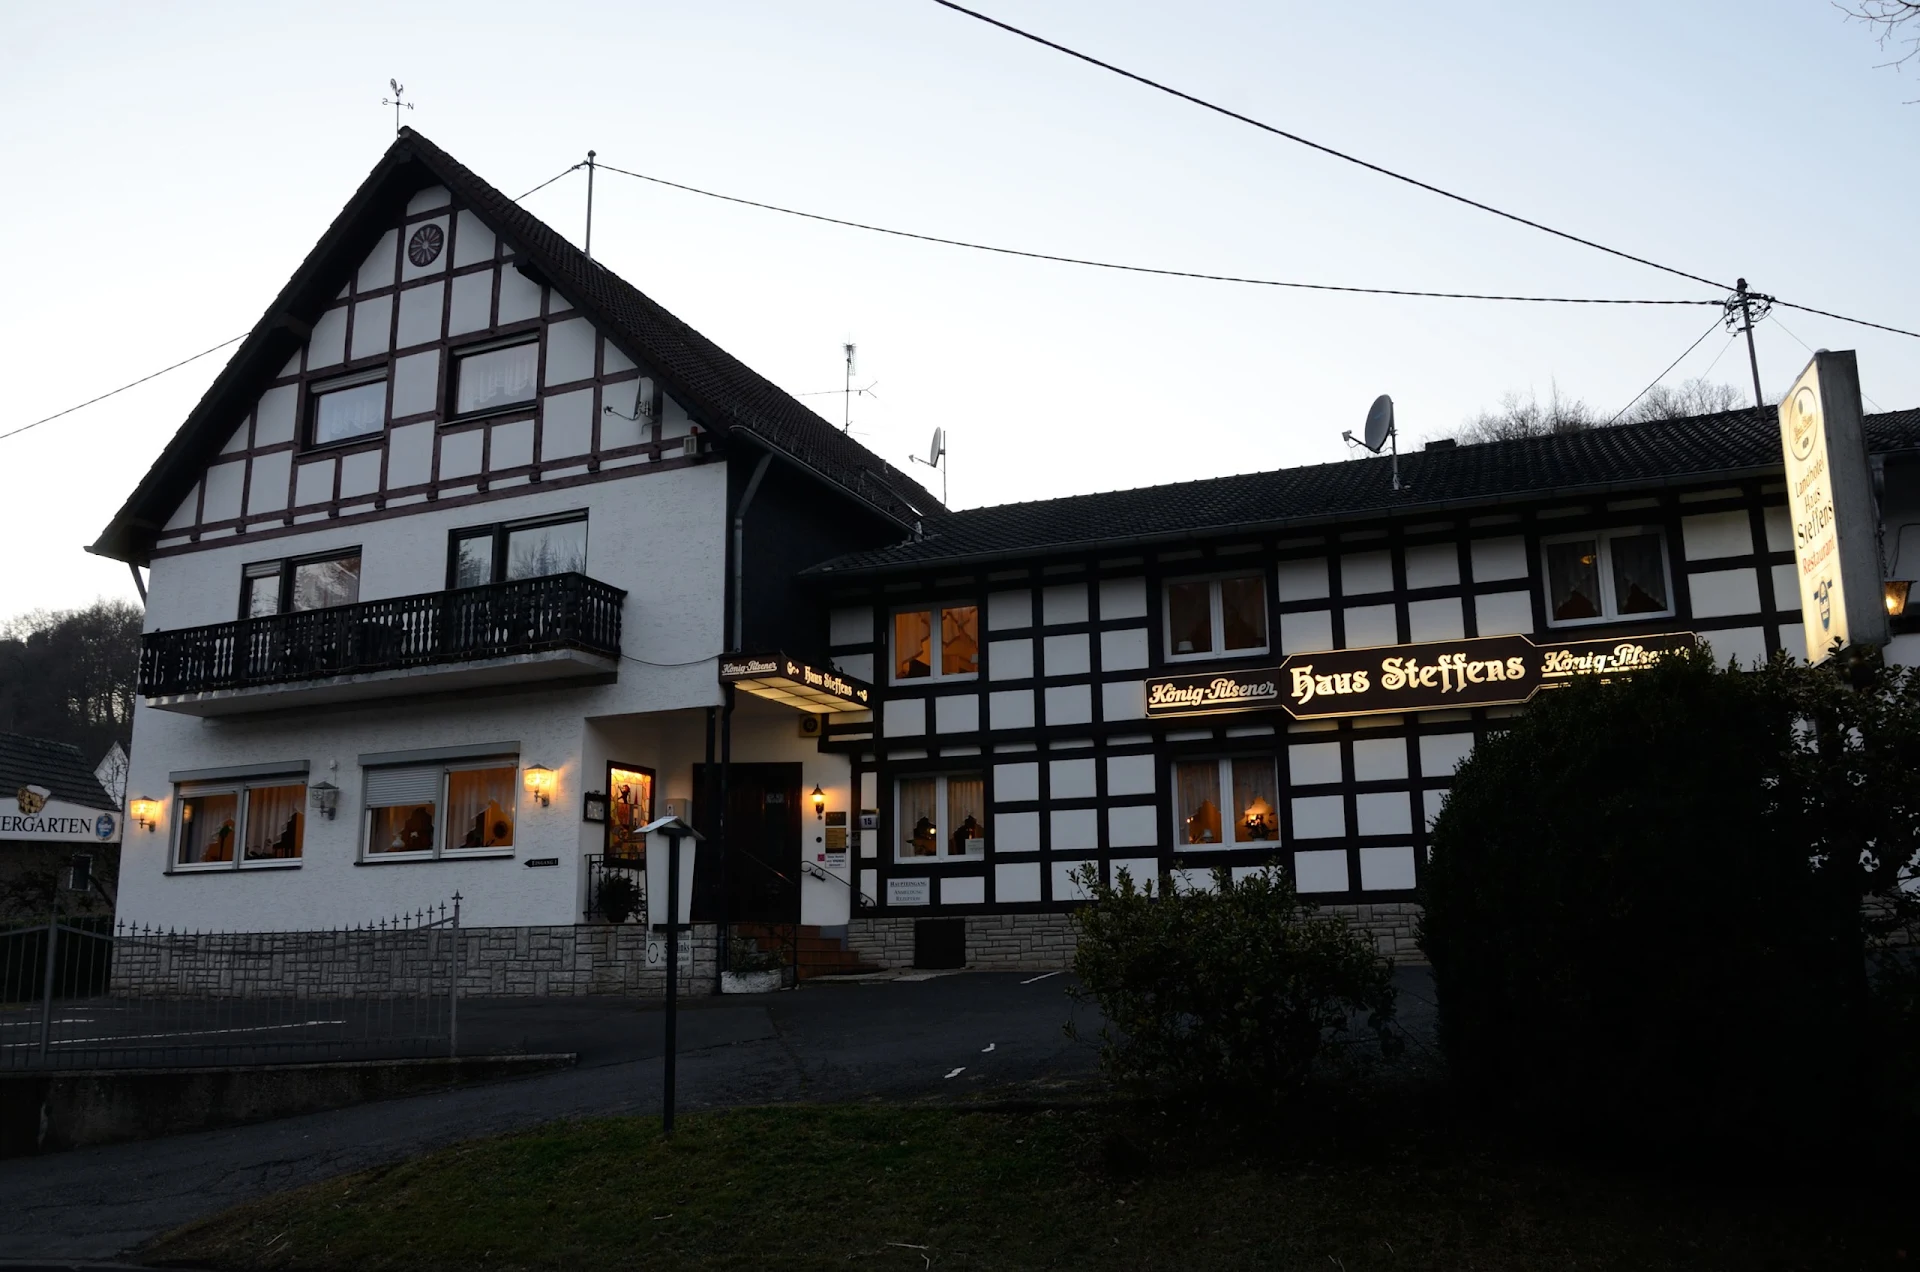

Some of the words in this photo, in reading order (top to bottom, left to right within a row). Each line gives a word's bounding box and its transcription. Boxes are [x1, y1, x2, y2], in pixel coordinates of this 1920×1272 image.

[1795, 450, 1825, 498] Landhotel
[1804, 487, 1821, 514] Haus
[1797, 500, 1833, 550] Steffens
[1802, 535, 1836, 576] Restaurant
[721, 660, 778, 675] König-Pilsener
[804, 665, 822, 685] Haus
[823, 672, 853, 696] Steffens
[1289, 664, 1370, 705] Haus
[1381, 653, 1526, 694] Steffens
[1148, 678, 1278, 707] König-Pilsener
[0, 815, 92, 834] ERGARTEN
[864, 817, 872, 826] 15
